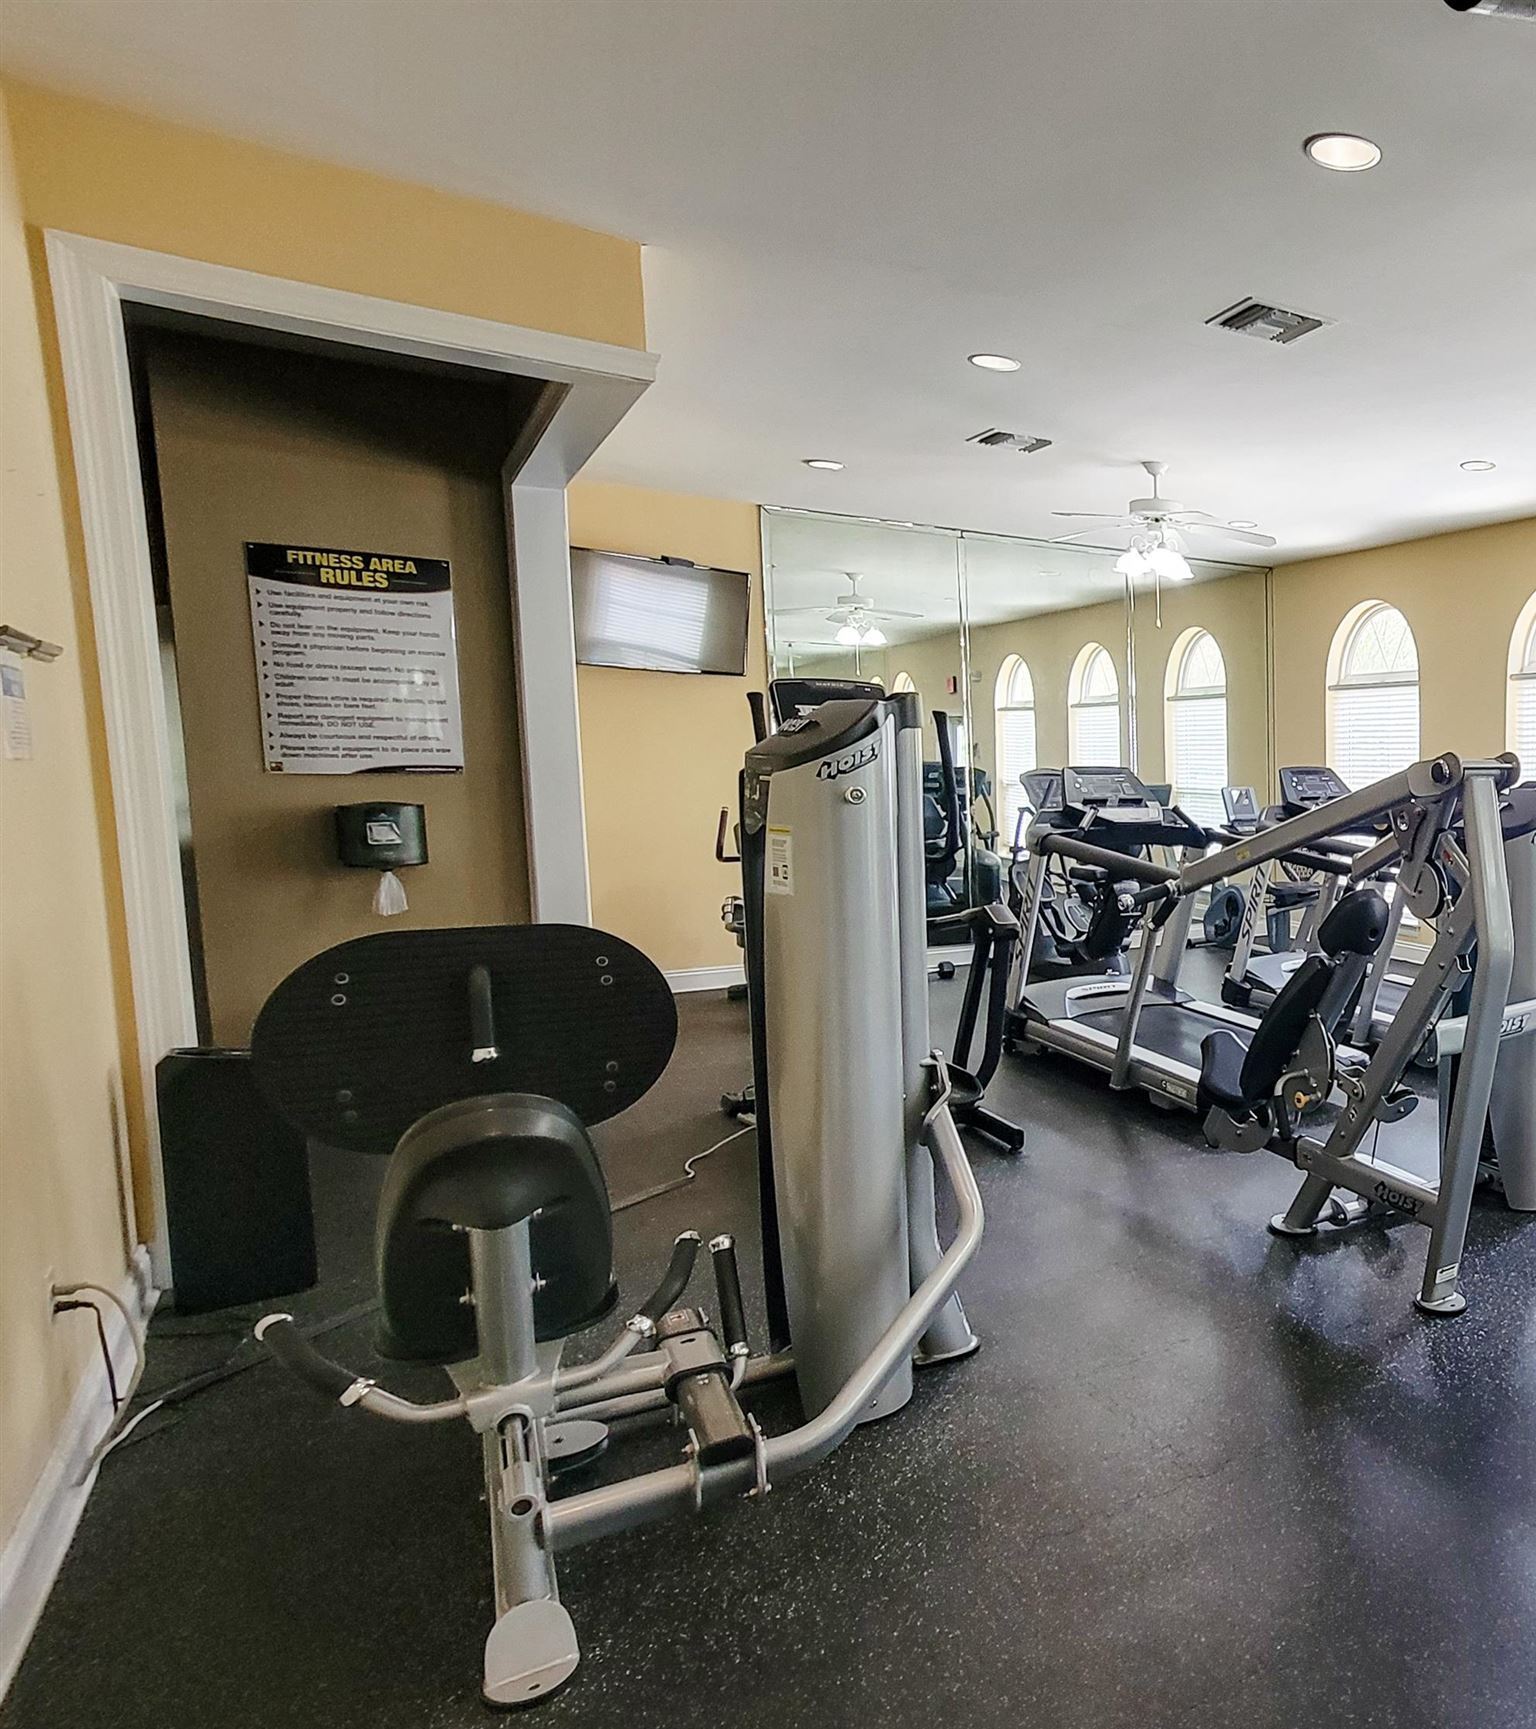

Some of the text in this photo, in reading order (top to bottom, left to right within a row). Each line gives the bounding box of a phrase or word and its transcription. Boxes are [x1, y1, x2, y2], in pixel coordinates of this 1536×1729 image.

[286, 550, 418, 575] FITNESS AREA
[320, 567, 389, 588] RULES
[816, 739, 881, 780] HOIST
[1500, 1012, 1531, 1038] OIST
[1375, 1181, 1425, 1217] HOIST
